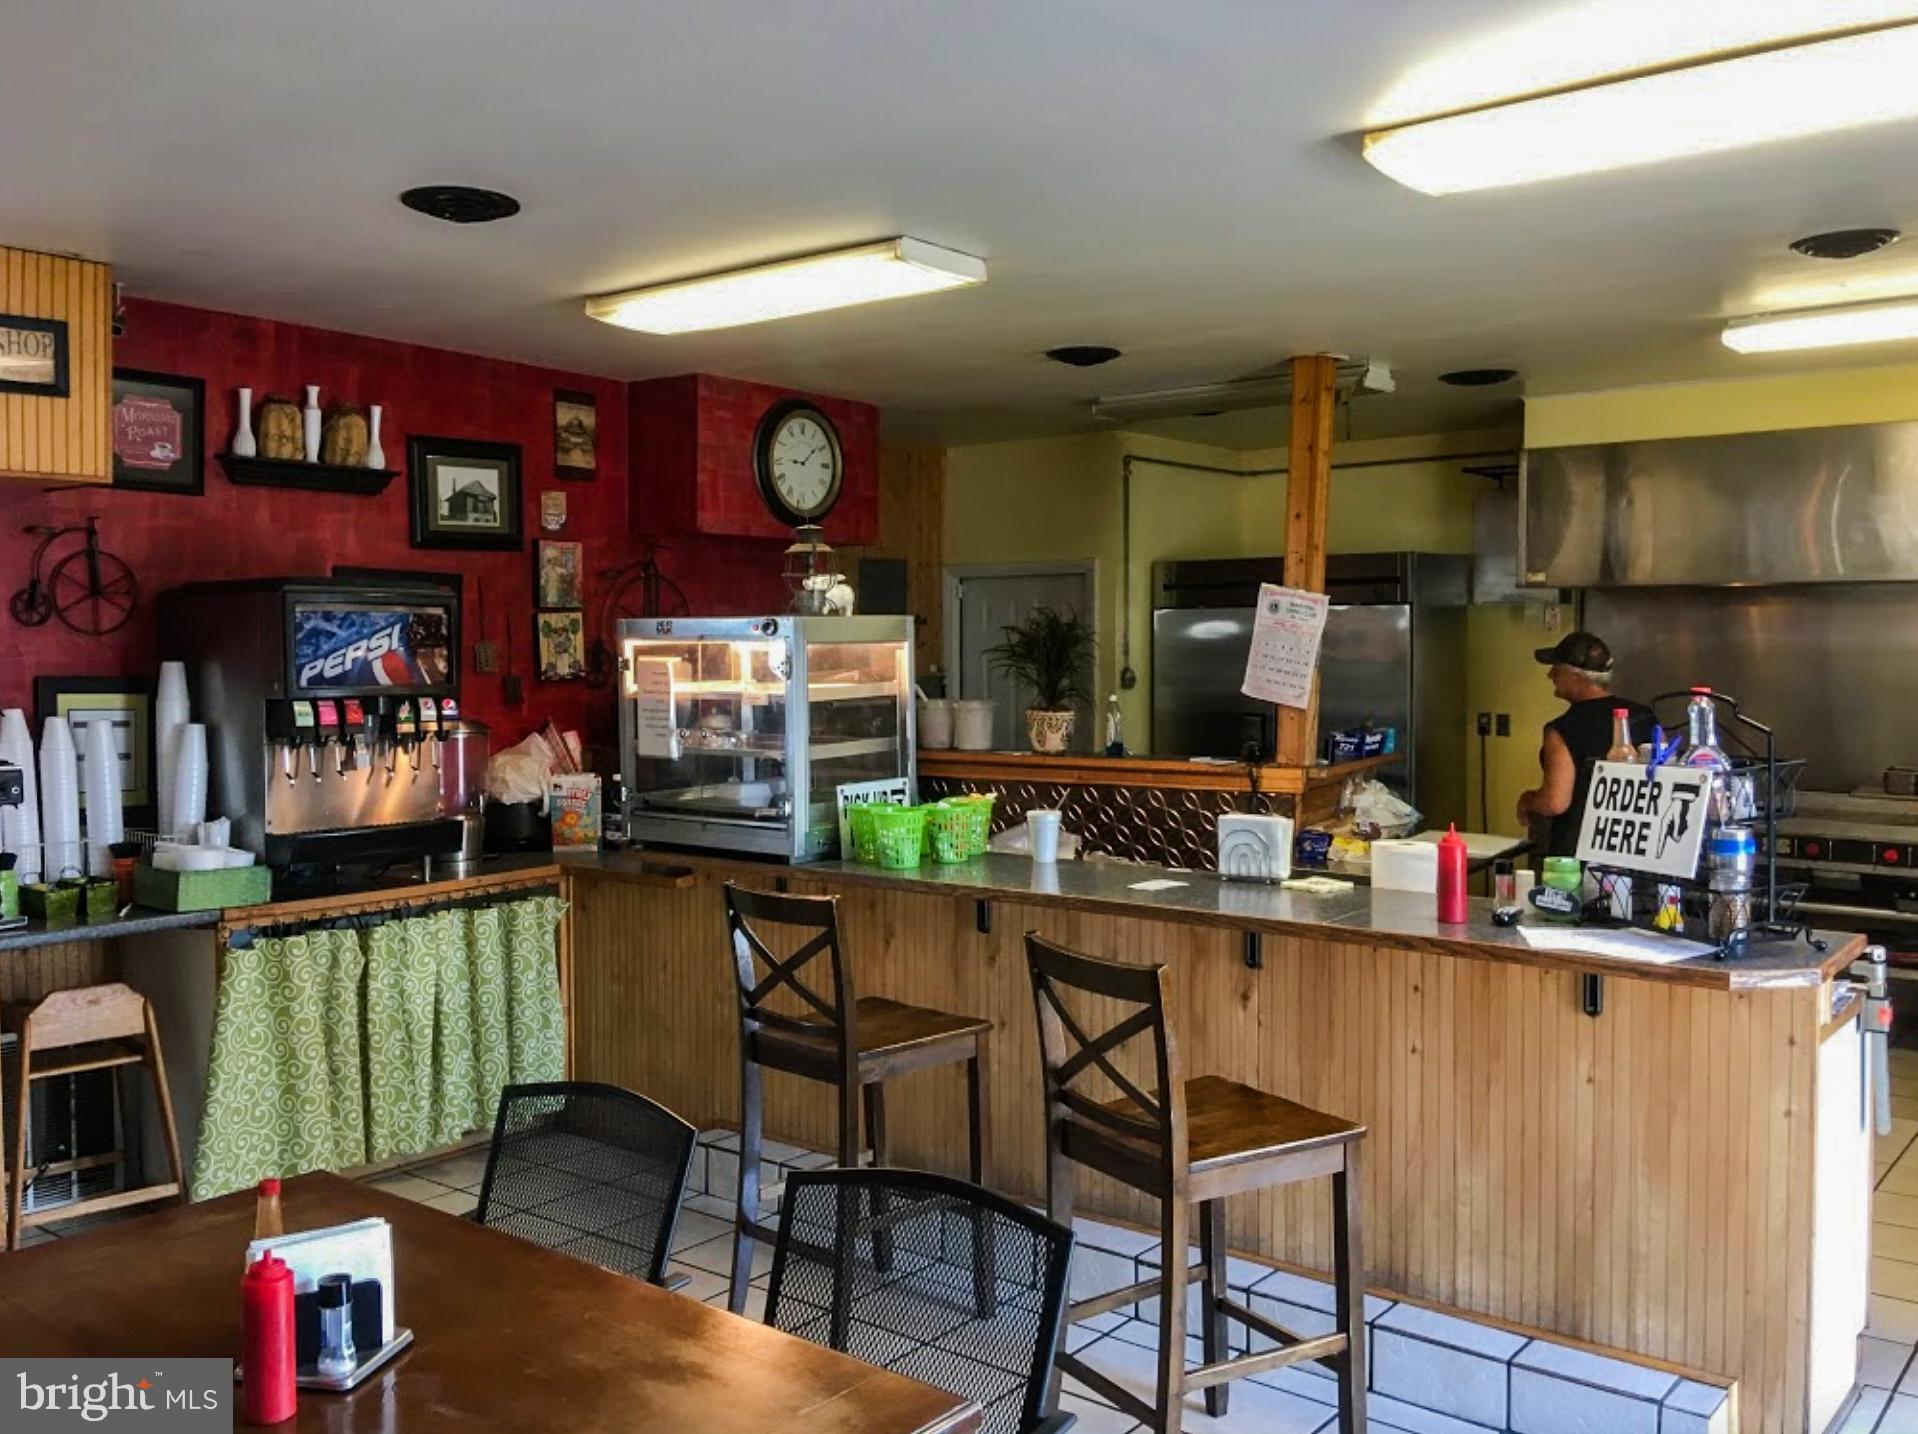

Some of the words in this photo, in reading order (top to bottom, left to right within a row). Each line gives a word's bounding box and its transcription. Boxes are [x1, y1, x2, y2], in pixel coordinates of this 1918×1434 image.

[123, 426, 168, 442] ROAST
[301, 622, 402, 687] PEPSI
[1593, 775, 1663, 817] ORDER
[1591, 816, 1652, 856] HERE
